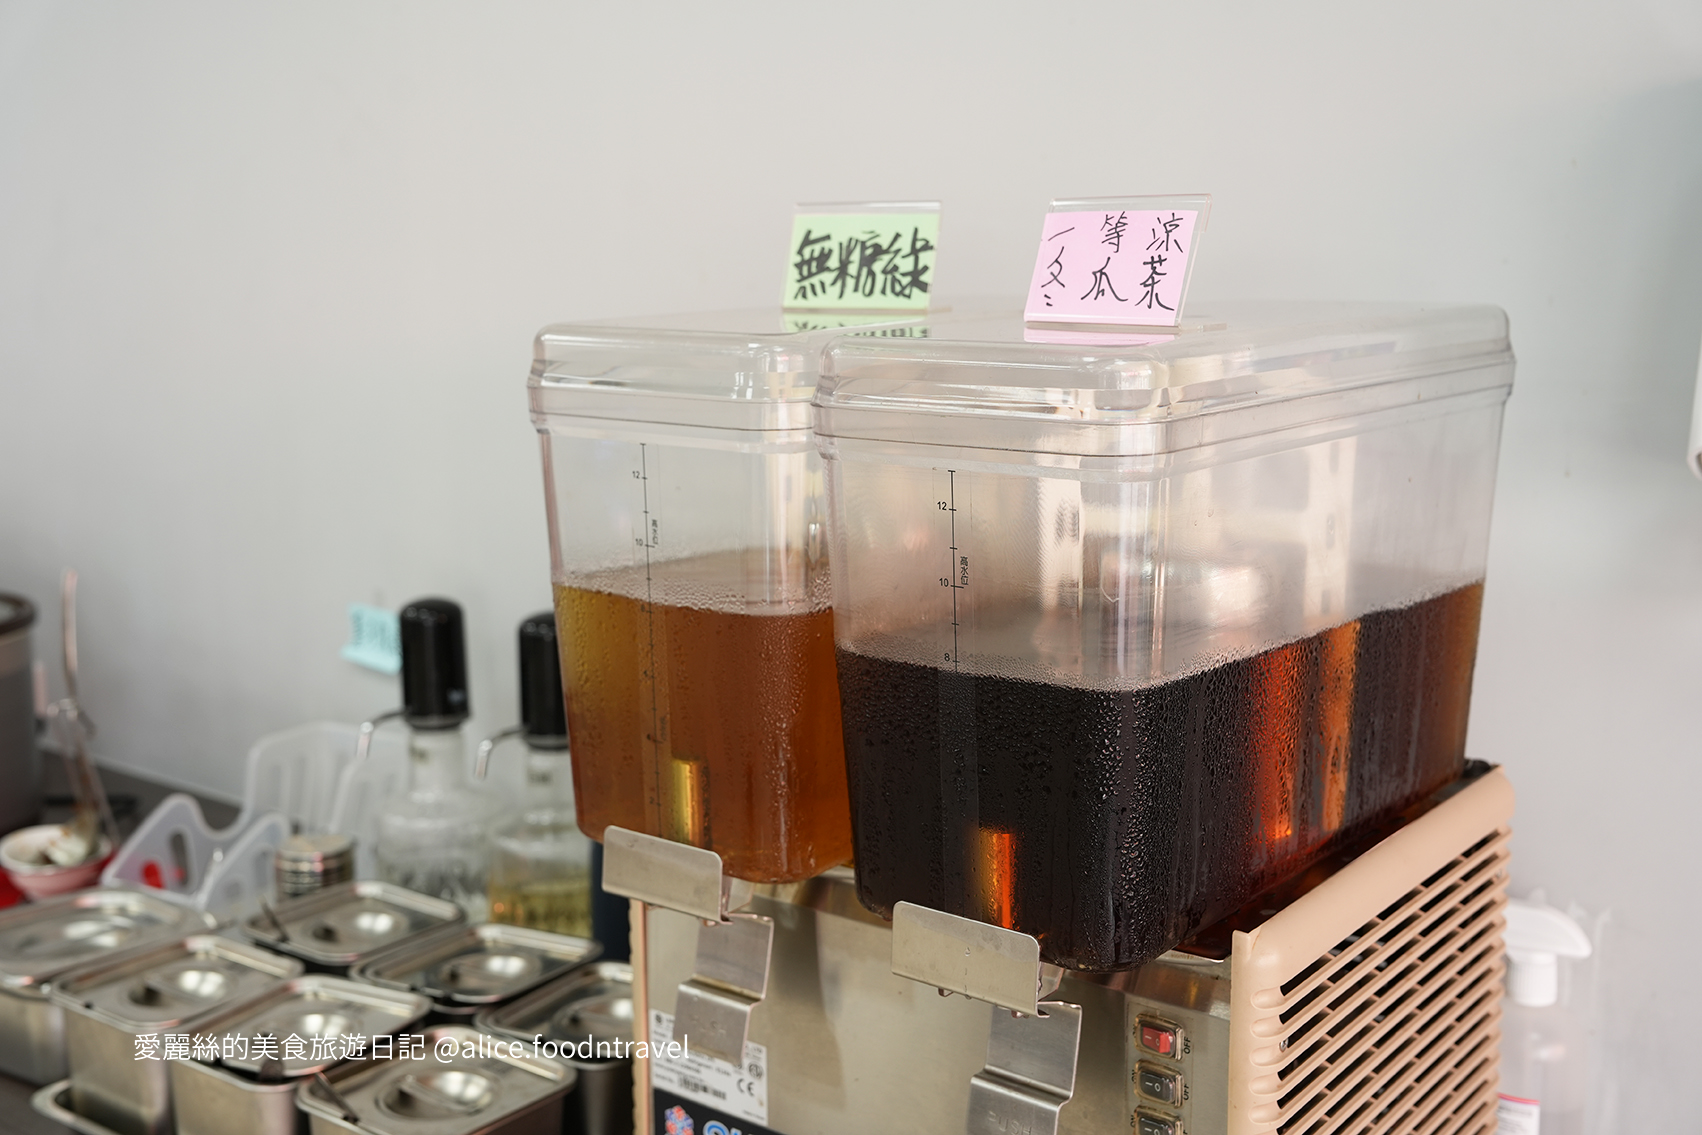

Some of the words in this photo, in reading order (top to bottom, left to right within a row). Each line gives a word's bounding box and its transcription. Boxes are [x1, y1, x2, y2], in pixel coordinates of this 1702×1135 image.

[793, 226, 934, 301] 無糖綠
[1040, 246, 1175, 312] 冬瓜茶
[632, 470, 641, 480] 12
[936, 501, 948, 511] 12
[635, 538, 644, 547] 10
[938, 577, 950, 588] 10
[944, 653, 951, 663] 8
[1183, 1036, 1191, 1054] OFF
